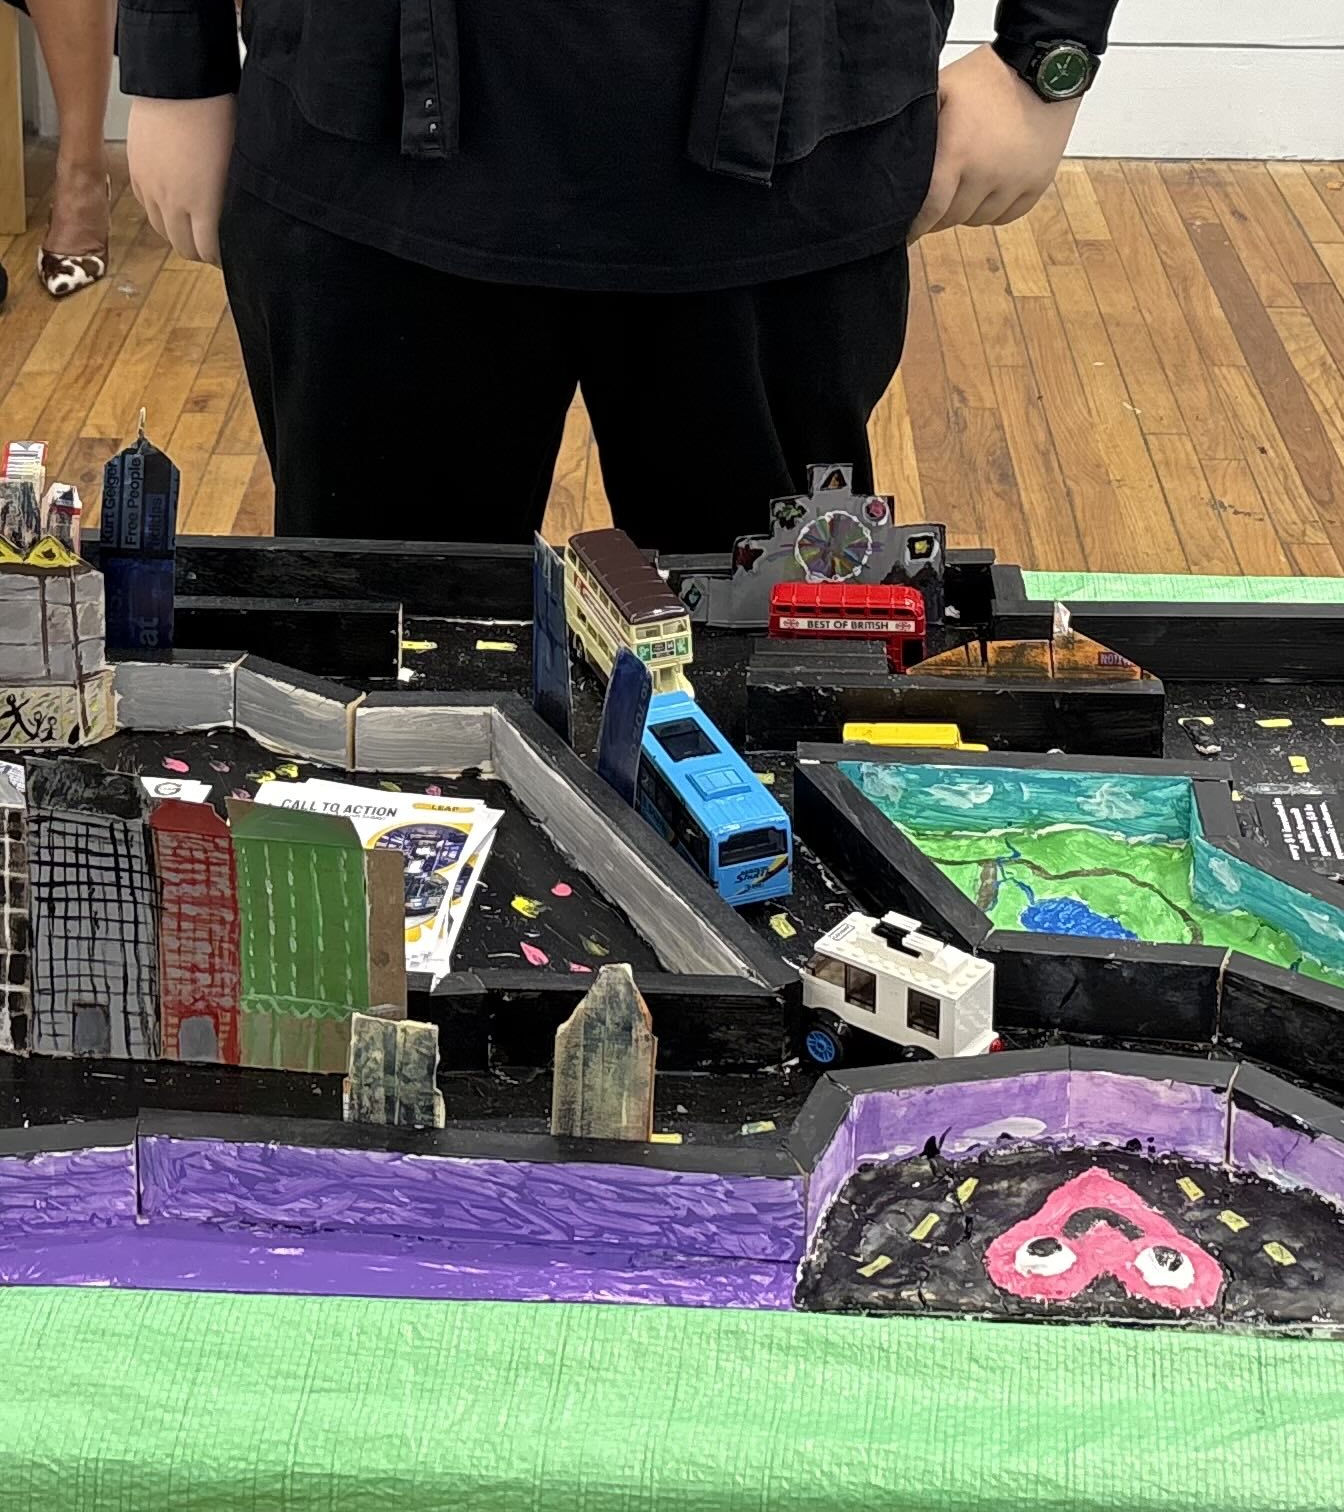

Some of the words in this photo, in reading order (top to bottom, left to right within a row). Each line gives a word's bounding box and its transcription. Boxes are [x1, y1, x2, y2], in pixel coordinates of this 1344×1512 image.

[129, 456, 144, 509] People
[125, 514, 138, 546] Free
[807, 620, 831, 630] BEST
[834, 620, 849, 630] OF
[851, 621, 889, 631] BRITISH
[280, 798, 318, 812] CALL
[322, 801, 340, 813] TO
[342, 803, 398, 817] ACTION
